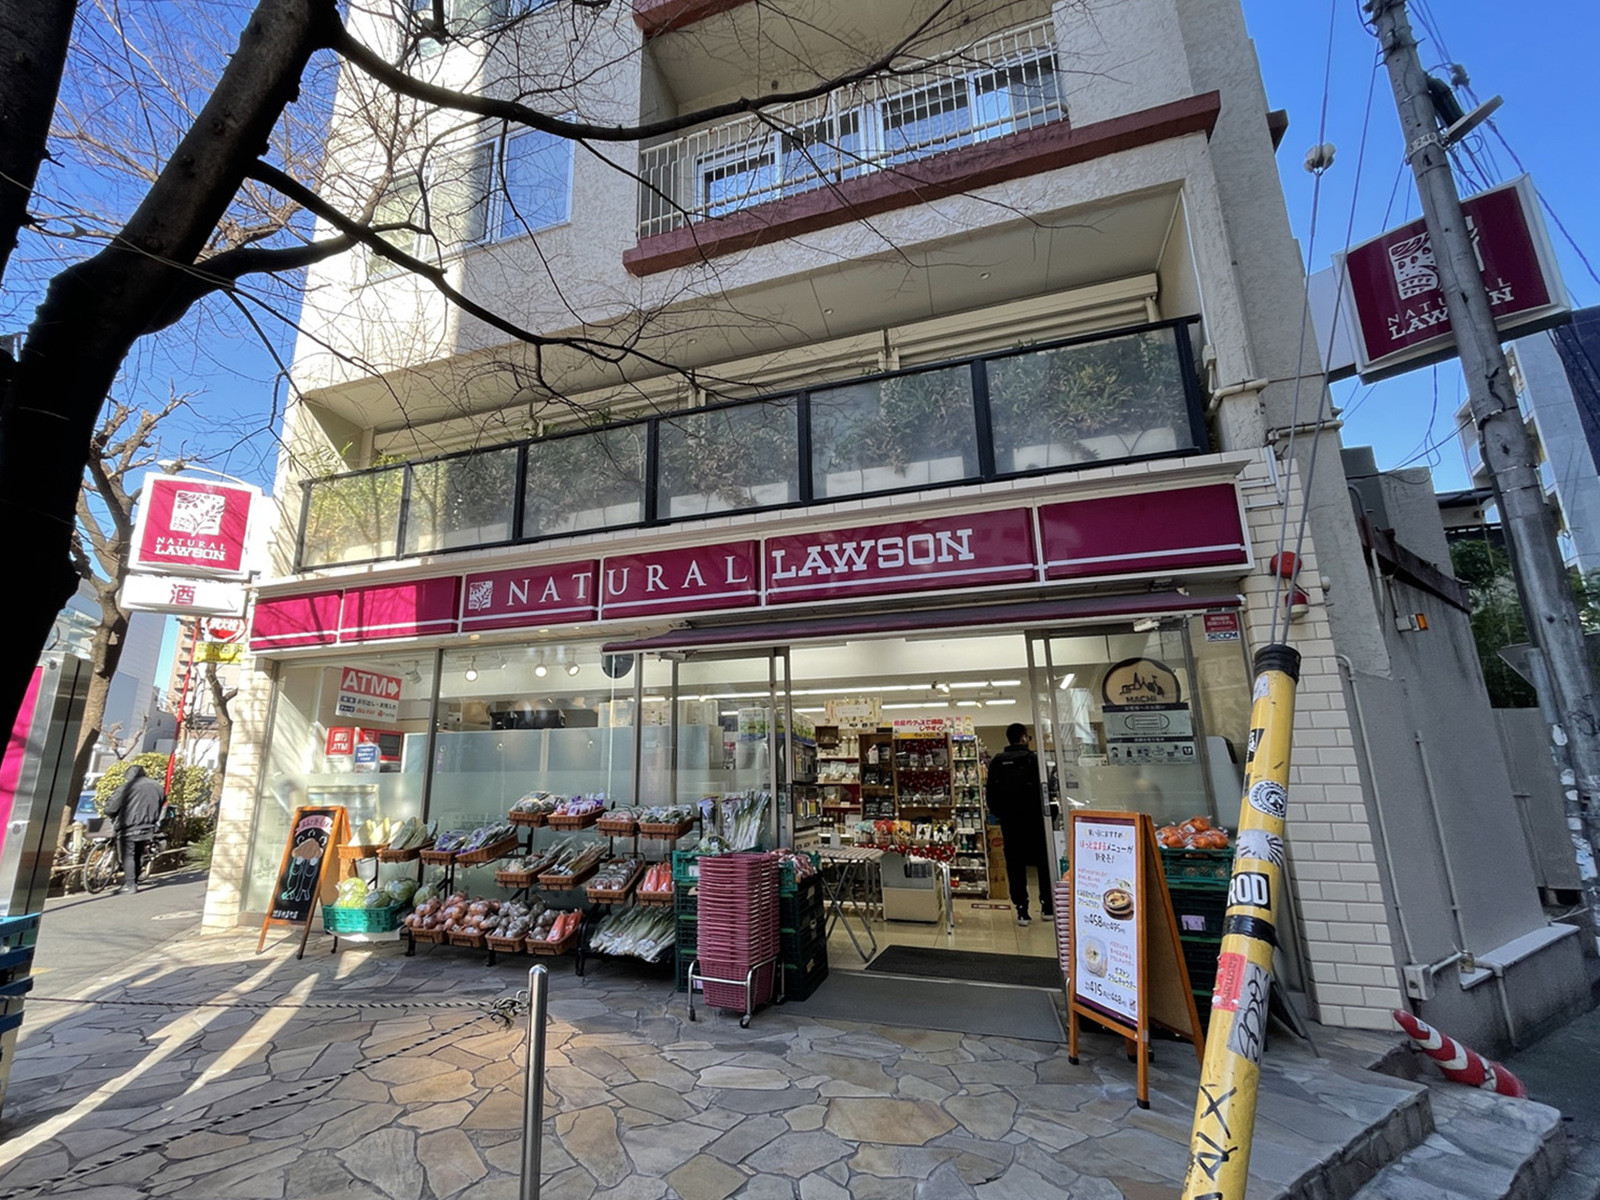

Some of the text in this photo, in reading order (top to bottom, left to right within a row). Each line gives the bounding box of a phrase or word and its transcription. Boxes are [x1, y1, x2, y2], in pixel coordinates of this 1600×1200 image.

[154, 544, 226, 561] LAWSON
[155, 536, 227, 552] NATURAL
[772, 528, 974, 579] LAWSON
[507, 555, 748, 606] NATURAL
[169, 583, 197, 605] 酒
[1207, 632, 1239, 640] SECOM
[342, 670, 388, 696] ATM
[331, 742, 348, 751] ATM
